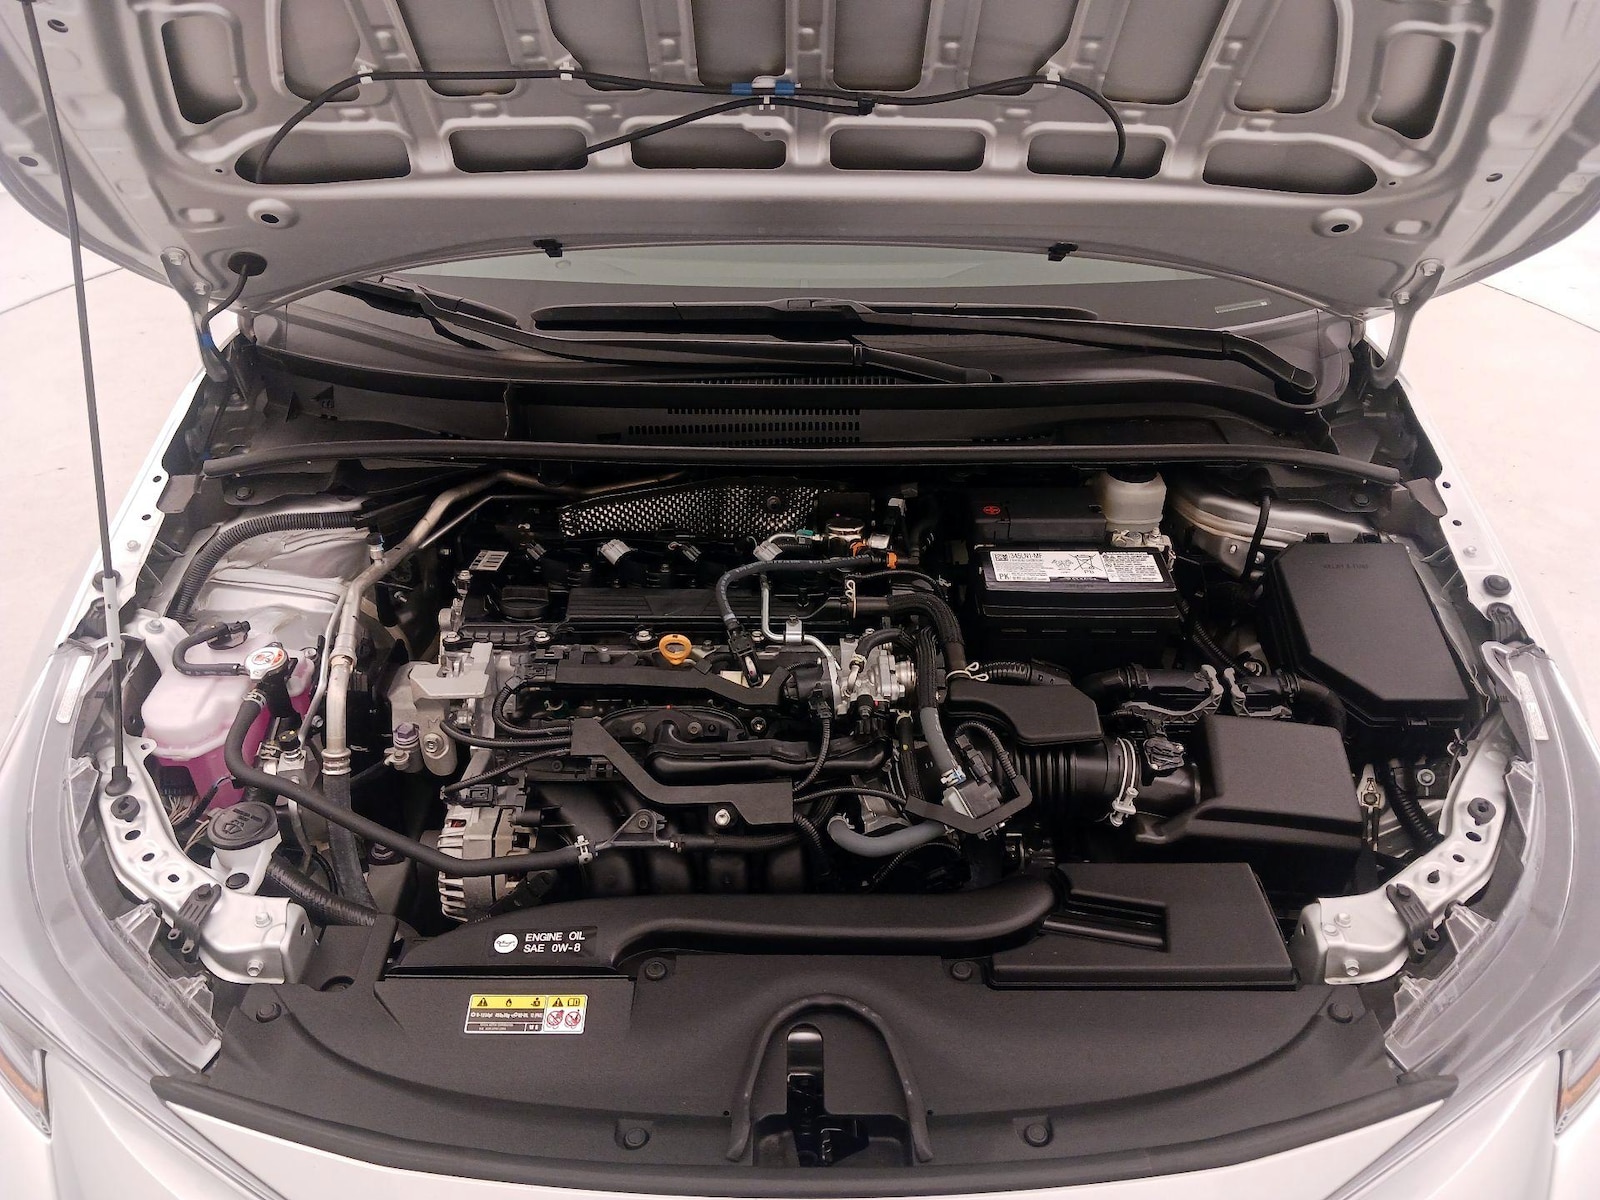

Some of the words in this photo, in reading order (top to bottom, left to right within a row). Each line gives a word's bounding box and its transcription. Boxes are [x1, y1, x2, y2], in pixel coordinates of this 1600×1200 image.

[525, 932, 563, 942] ENGINE
[568, 930, 586, 941] OIL
[523, 943, 545, 953] SAE
[551, 942, 581, 953] 0W-8
